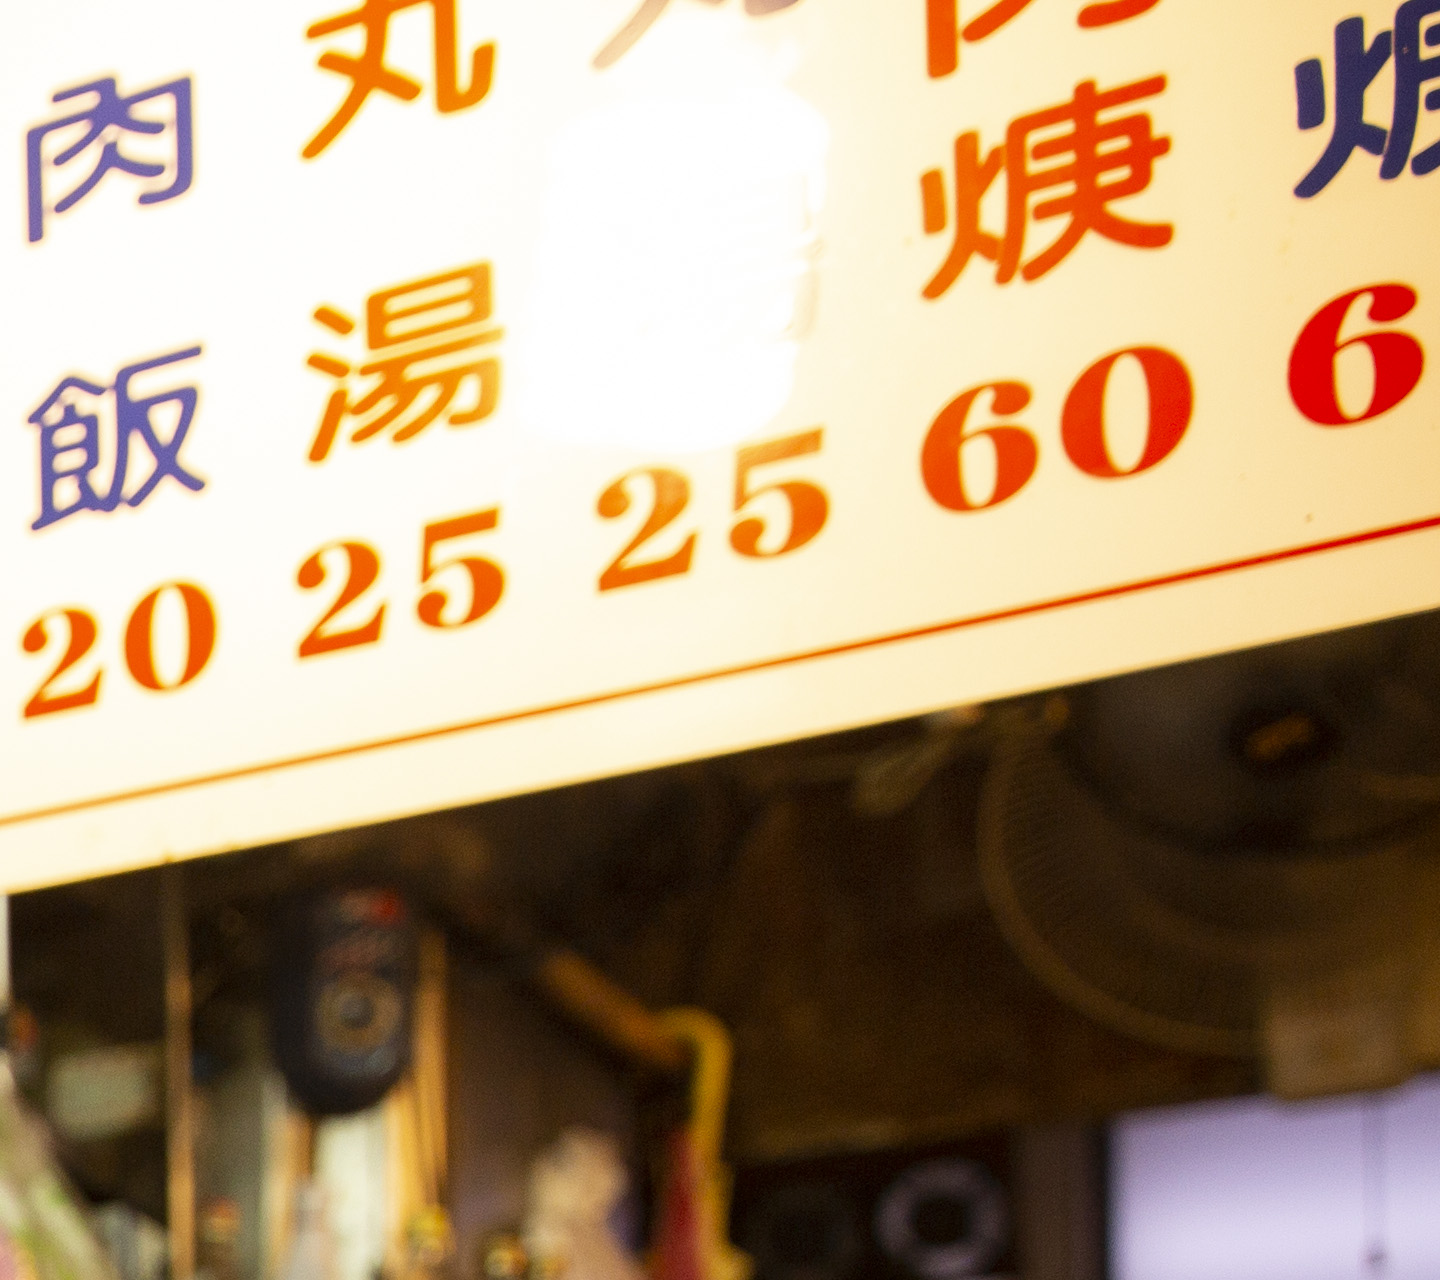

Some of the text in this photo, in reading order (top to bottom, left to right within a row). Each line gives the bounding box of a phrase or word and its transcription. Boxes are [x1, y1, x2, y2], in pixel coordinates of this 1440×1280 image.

[25, 75, 207, 531] 肉飯
[300, 0, 504, 464] 丸湯
[21, 580, 218, 720] 20
[296, 505, 507, 660] 25
[596, 428, 831, 593] 25
[920, 345, 1195, 514] 60
